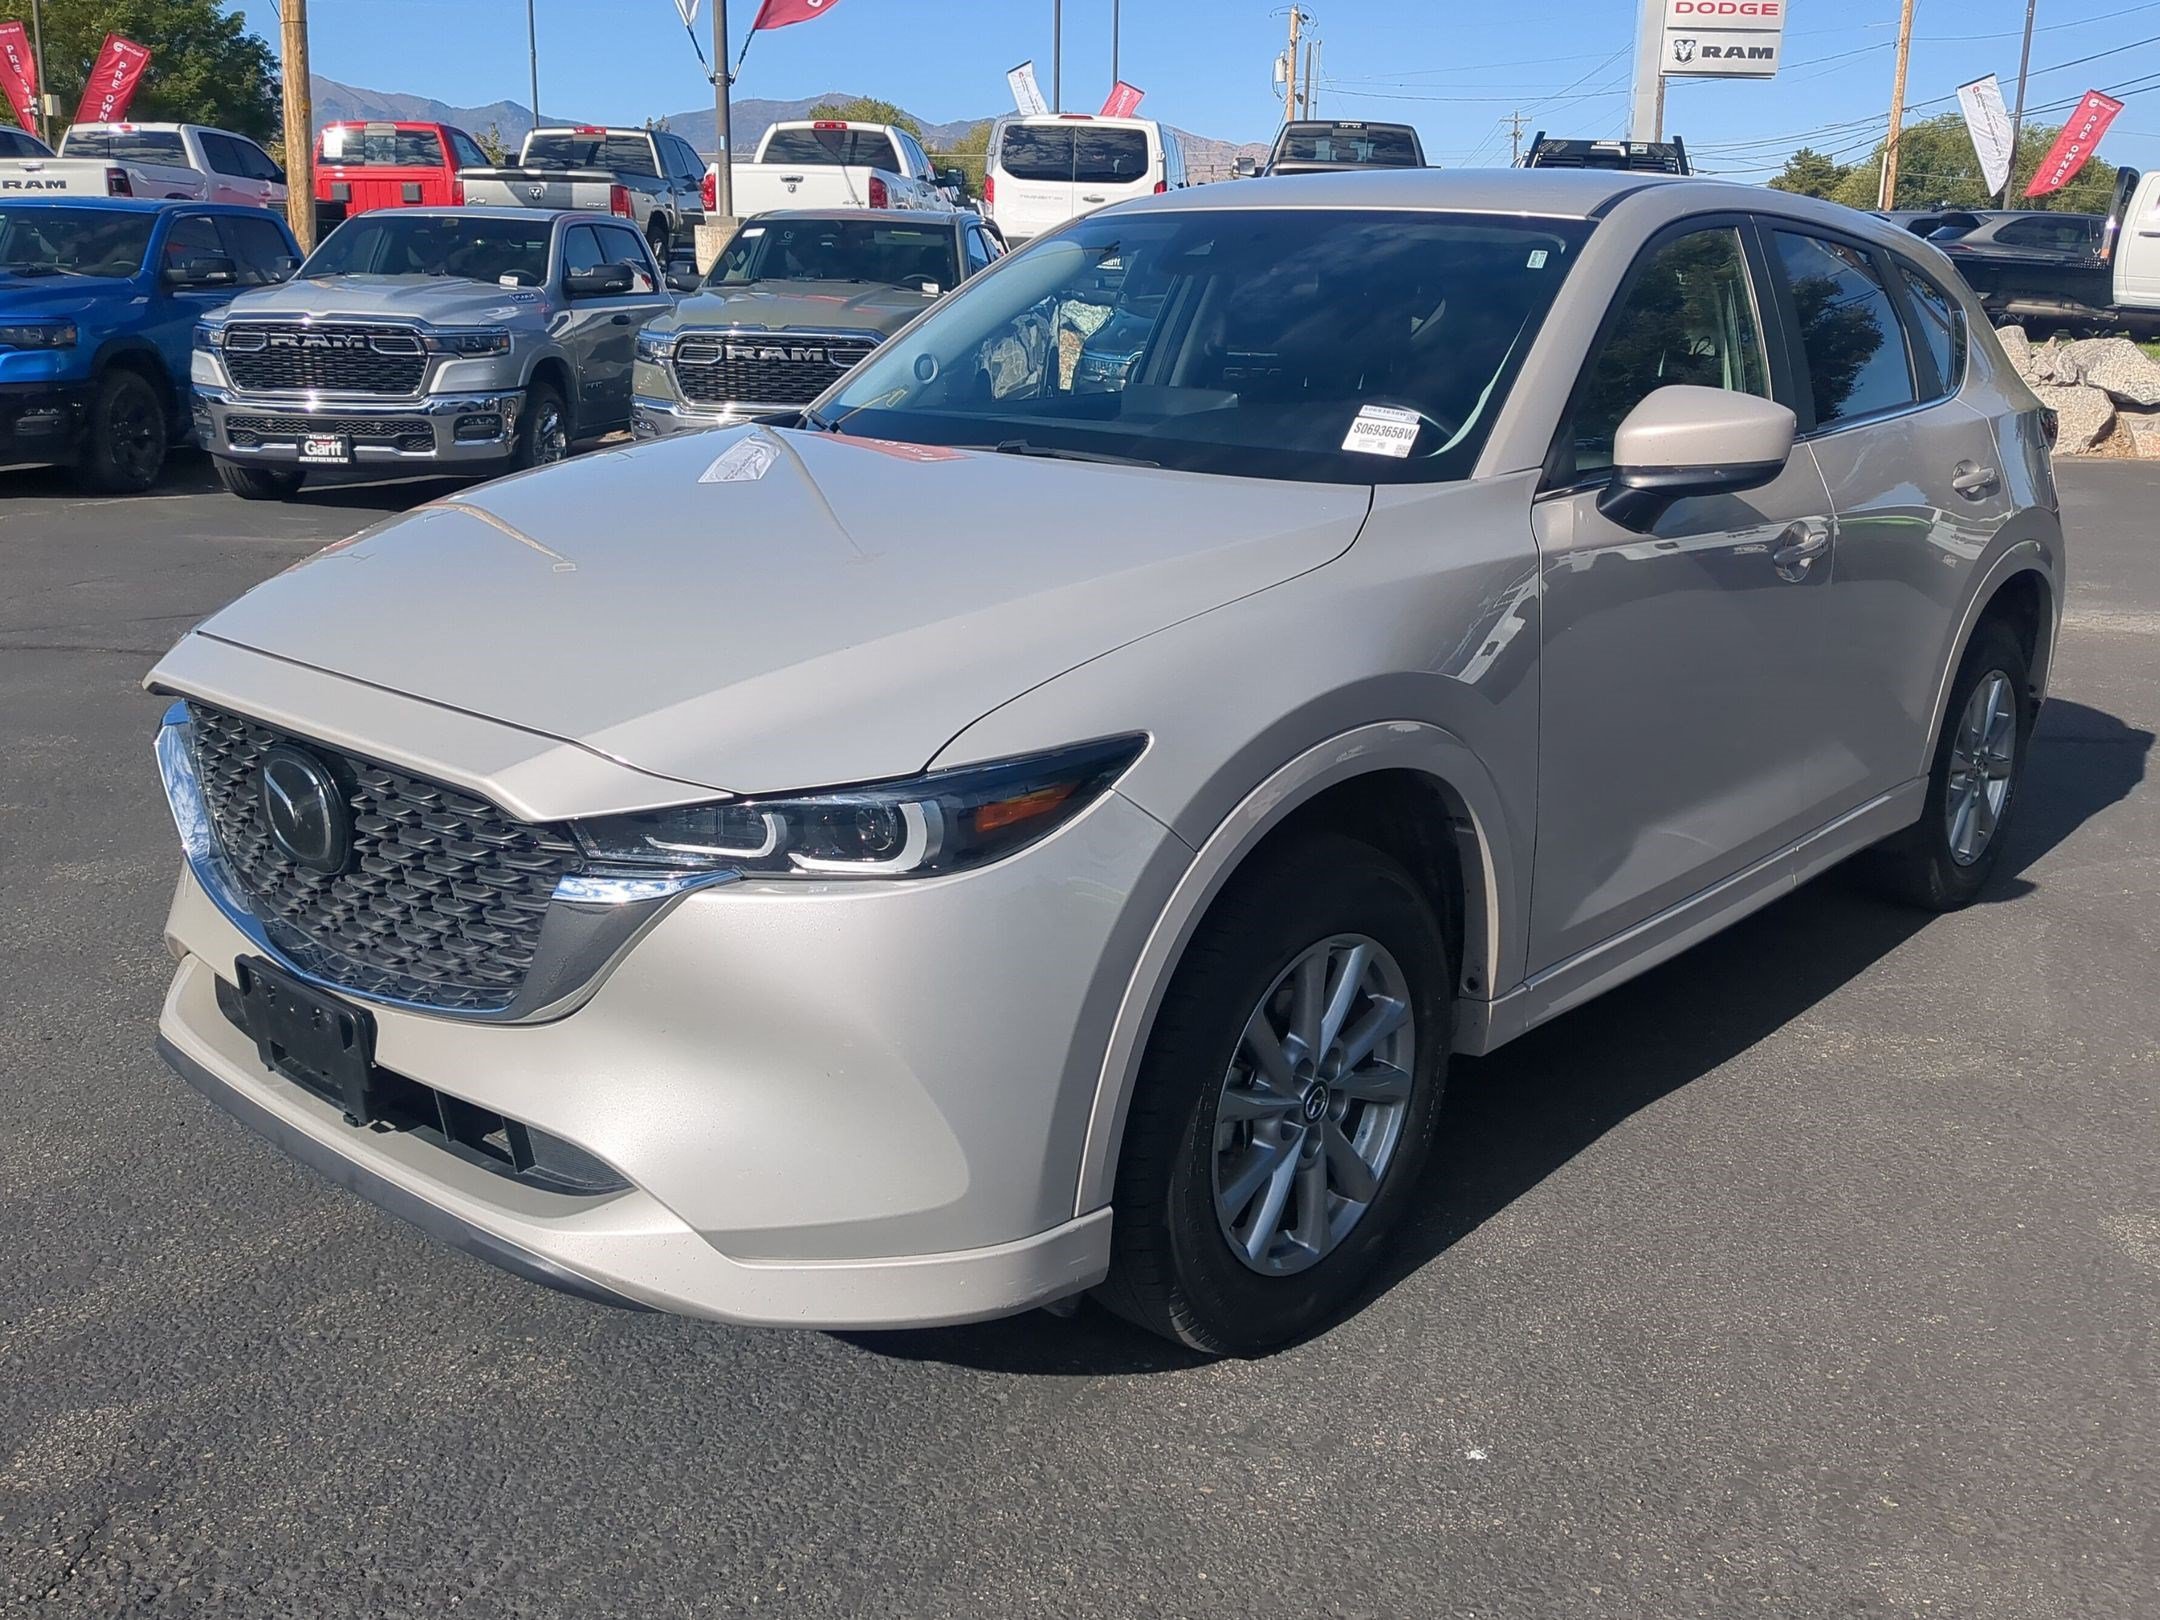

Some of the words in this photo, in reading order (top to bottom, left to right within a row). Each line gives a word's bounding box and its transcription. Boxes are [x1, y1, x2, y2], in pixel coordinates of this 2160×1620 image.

[1675, 2, 1779, 15] DODGE
[6, 44, 22, 73] PRE
[1701, 46, 1774, 59] RAM
[111, 61, 127, 89] PRE
[99, 94, 115, 122] OWN
[2079, 115, 2097, 140] PRE
[2050, 145, 2079, 185] OWNED
[2, 180, 67, 189] RAM
[270, 332, 364, 348] RAM
[726, 345, 823, 361] RAM
[1353, 422, 1416, 441] S0693658W
[304, 440, 342, 456] Garff
